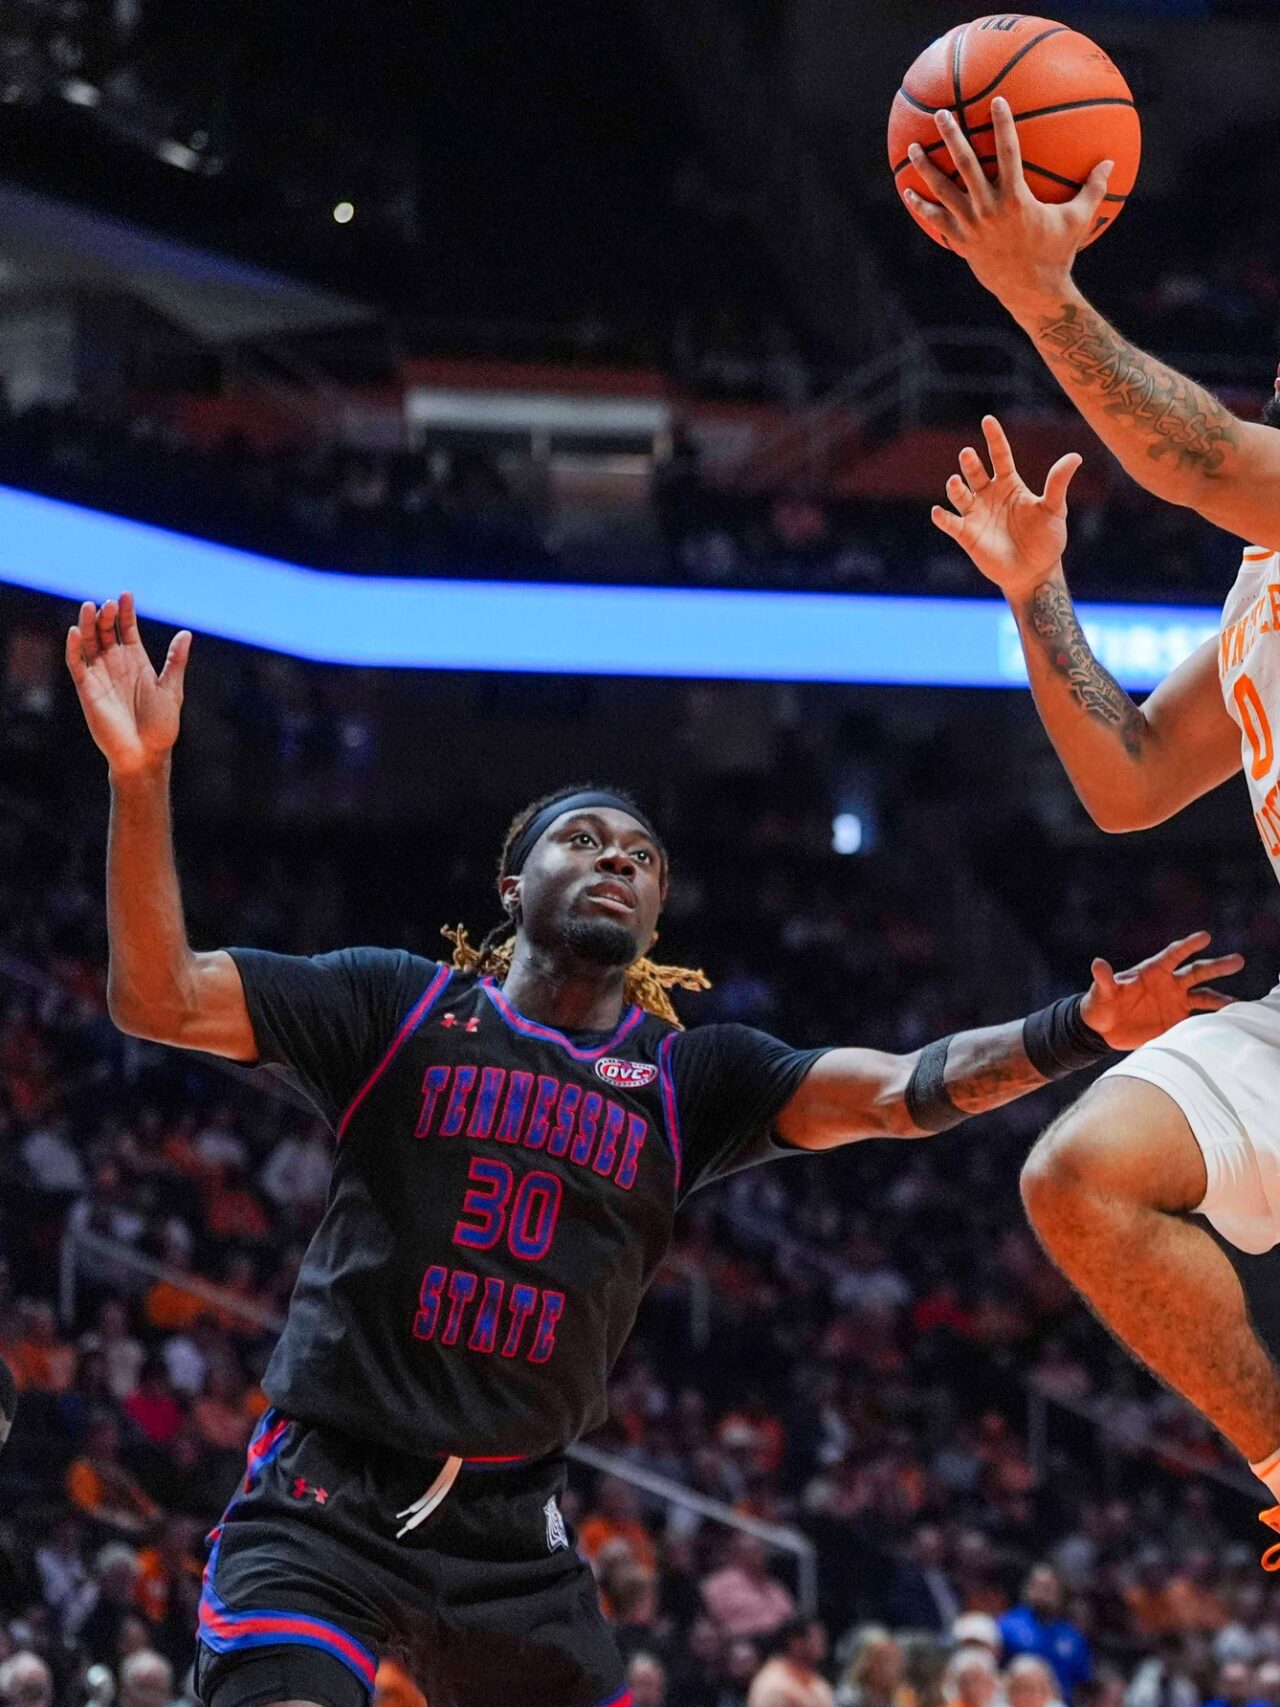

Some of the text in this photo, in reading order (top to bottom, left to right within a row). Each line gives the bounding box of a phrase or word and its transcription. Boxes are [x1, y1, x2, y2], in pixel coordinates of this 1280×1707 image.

[1234, 674, 1274, 781] 0
[414, 1065, 648, 1190] TENNESSEE
[453, 1156, 562, 1261] 30
[413, 1264, 566, 1364] STATE
